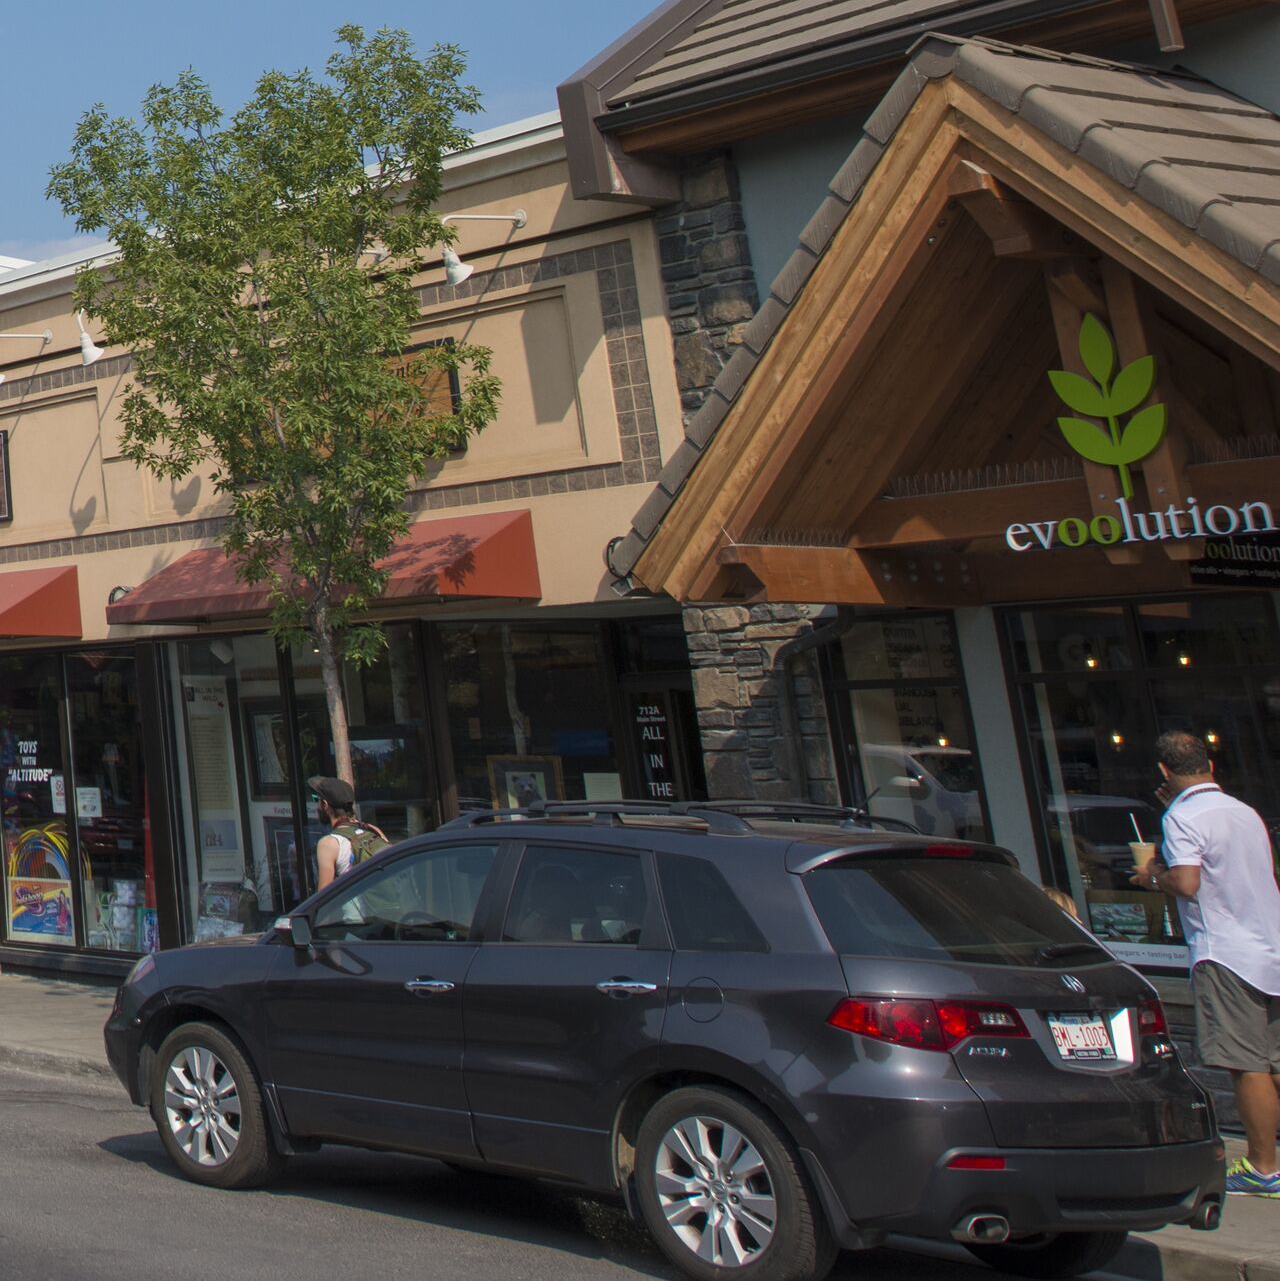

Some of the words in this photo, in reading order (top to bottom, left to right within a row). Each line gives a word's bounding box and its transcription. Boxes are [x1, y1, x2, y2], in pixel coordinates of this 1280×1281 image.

[1005, 496, 1280, 551] evoolution
[638, 706, 660, 715] 712A
[642, 726, 665, 740] ALL
[17, 740, 38, 754] TOYS
[21, 756, 37, 766] WITH
[650, 753, 664, 768] IN
[8, 768, 53, 782] "ALTITUDE"
[648, 782, 673, 797] THE
[1113, 949, 1140, 957] inegars
[1147, 951, 1172, 960] tasting
[969, 1046, 1011, 1057] ACURA
